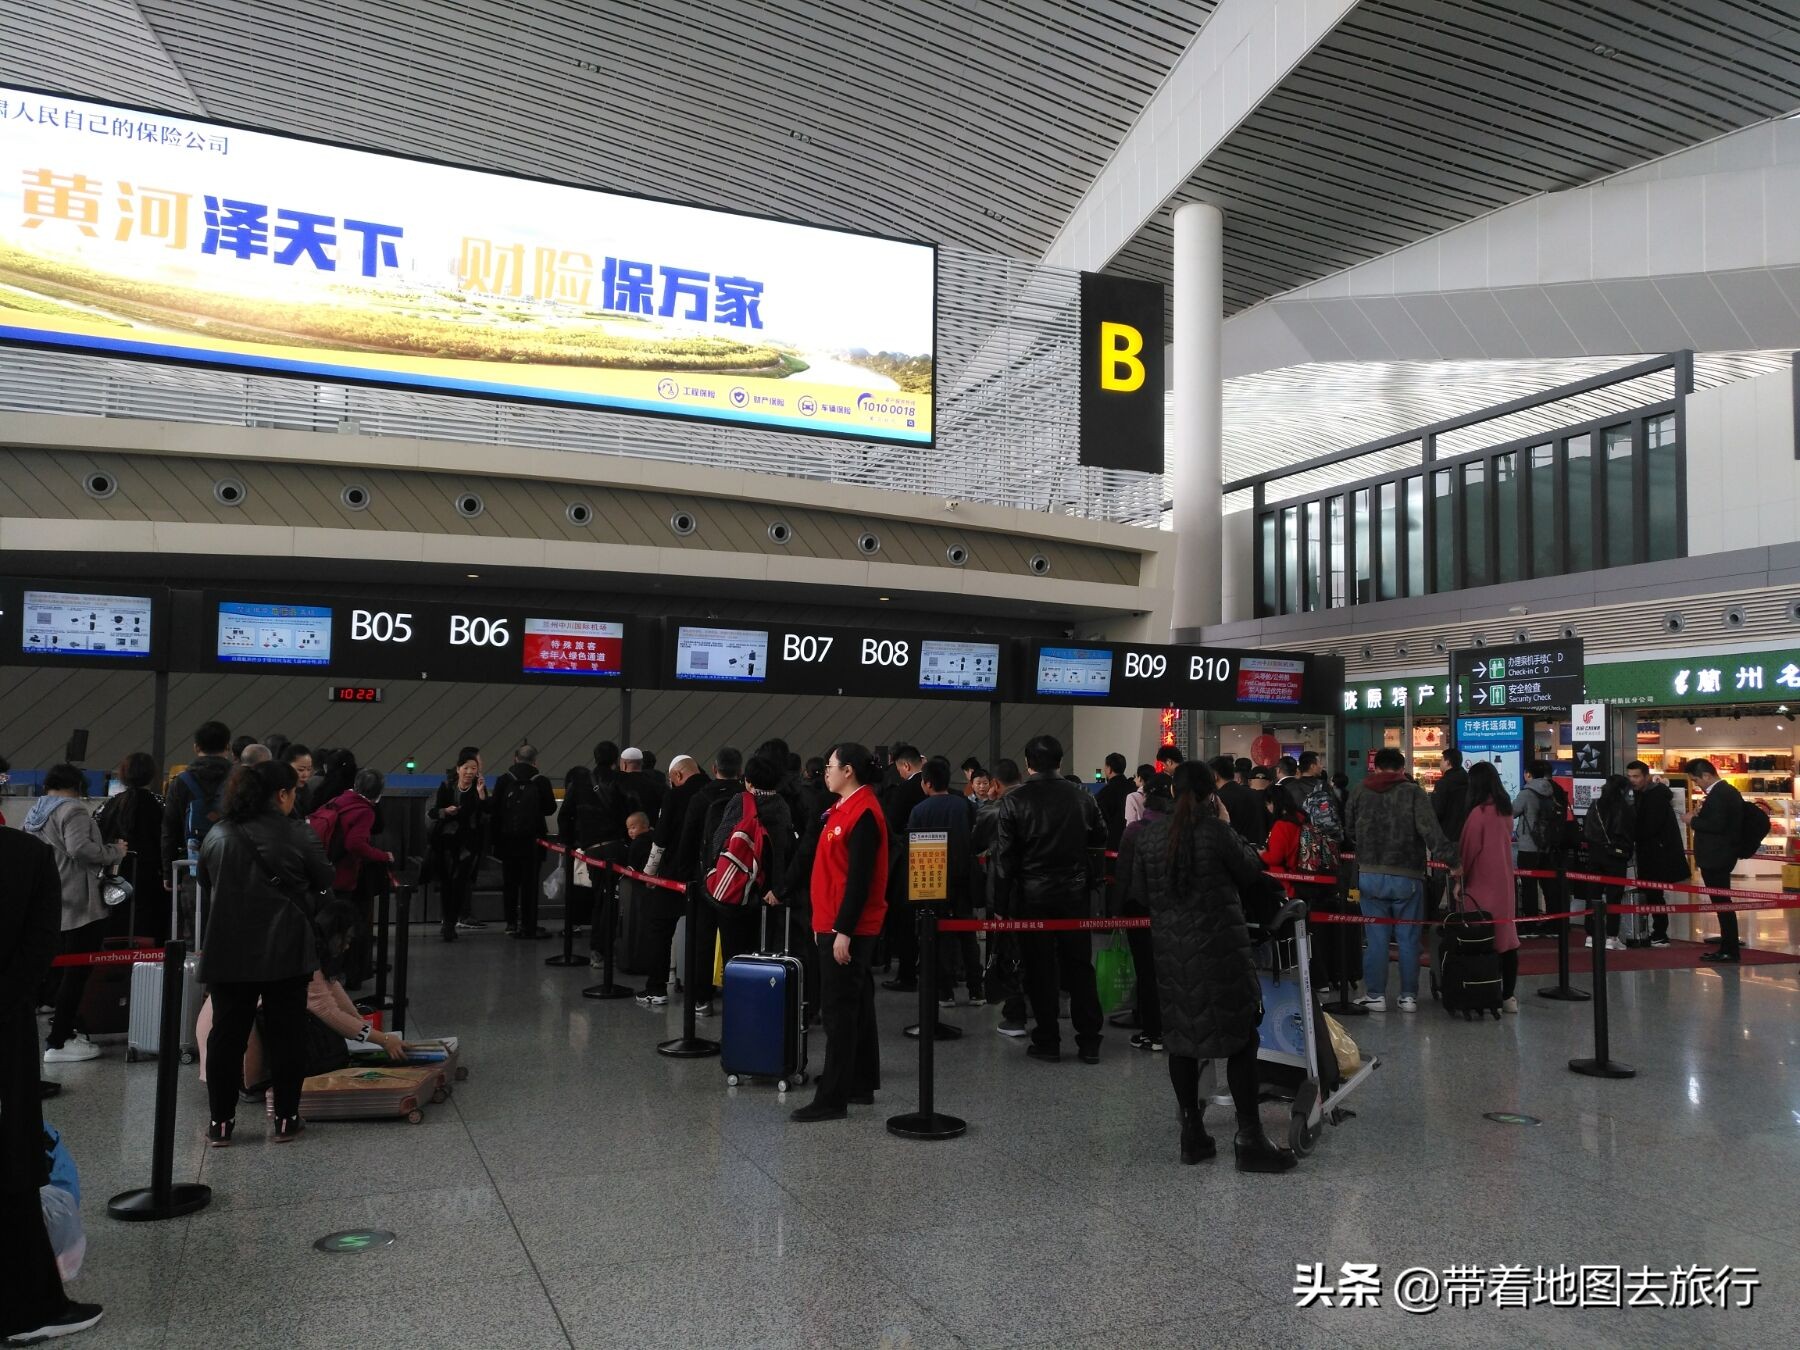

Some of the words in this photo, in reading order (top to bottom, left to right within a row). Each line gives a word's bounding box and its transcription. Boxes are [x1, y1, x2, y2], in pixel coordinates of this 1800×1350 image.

[22, 167, 404, 278] 黄河泽天下
[457, 234, 764, 330] 财险保万家
[1100, 320, 1146, 393] B
[682, 386, 716, 399] 工程保险
[753, 394, 786, 407] 财产保险
[863, 401, 888, 413] 1010
[889, 405, 916, 417] 0018
[351, 609, 413, 643] B05
[449, 615, 510, 648] B06
[550, 640, 597, 651] 特殊旅客
[783, 634, 833, 663] B07
[861, 638, 909, 667] B08
[540, 650, 606, 662] 老年人绿色通道
[1125, 652, 1167, 680] B09
[1189, 655, 1230, 682] B10
[1508, 667, 1533, 677] Check-in
[1508, 683, 1541, 695] 安全检查
[1508, 694, 1532, 704] Security
[1533, 693, 1552, 702] Check
[1464, 719, 1517, 731] 行李托运须知
[88, 952, 131, 963] Lanzhou
